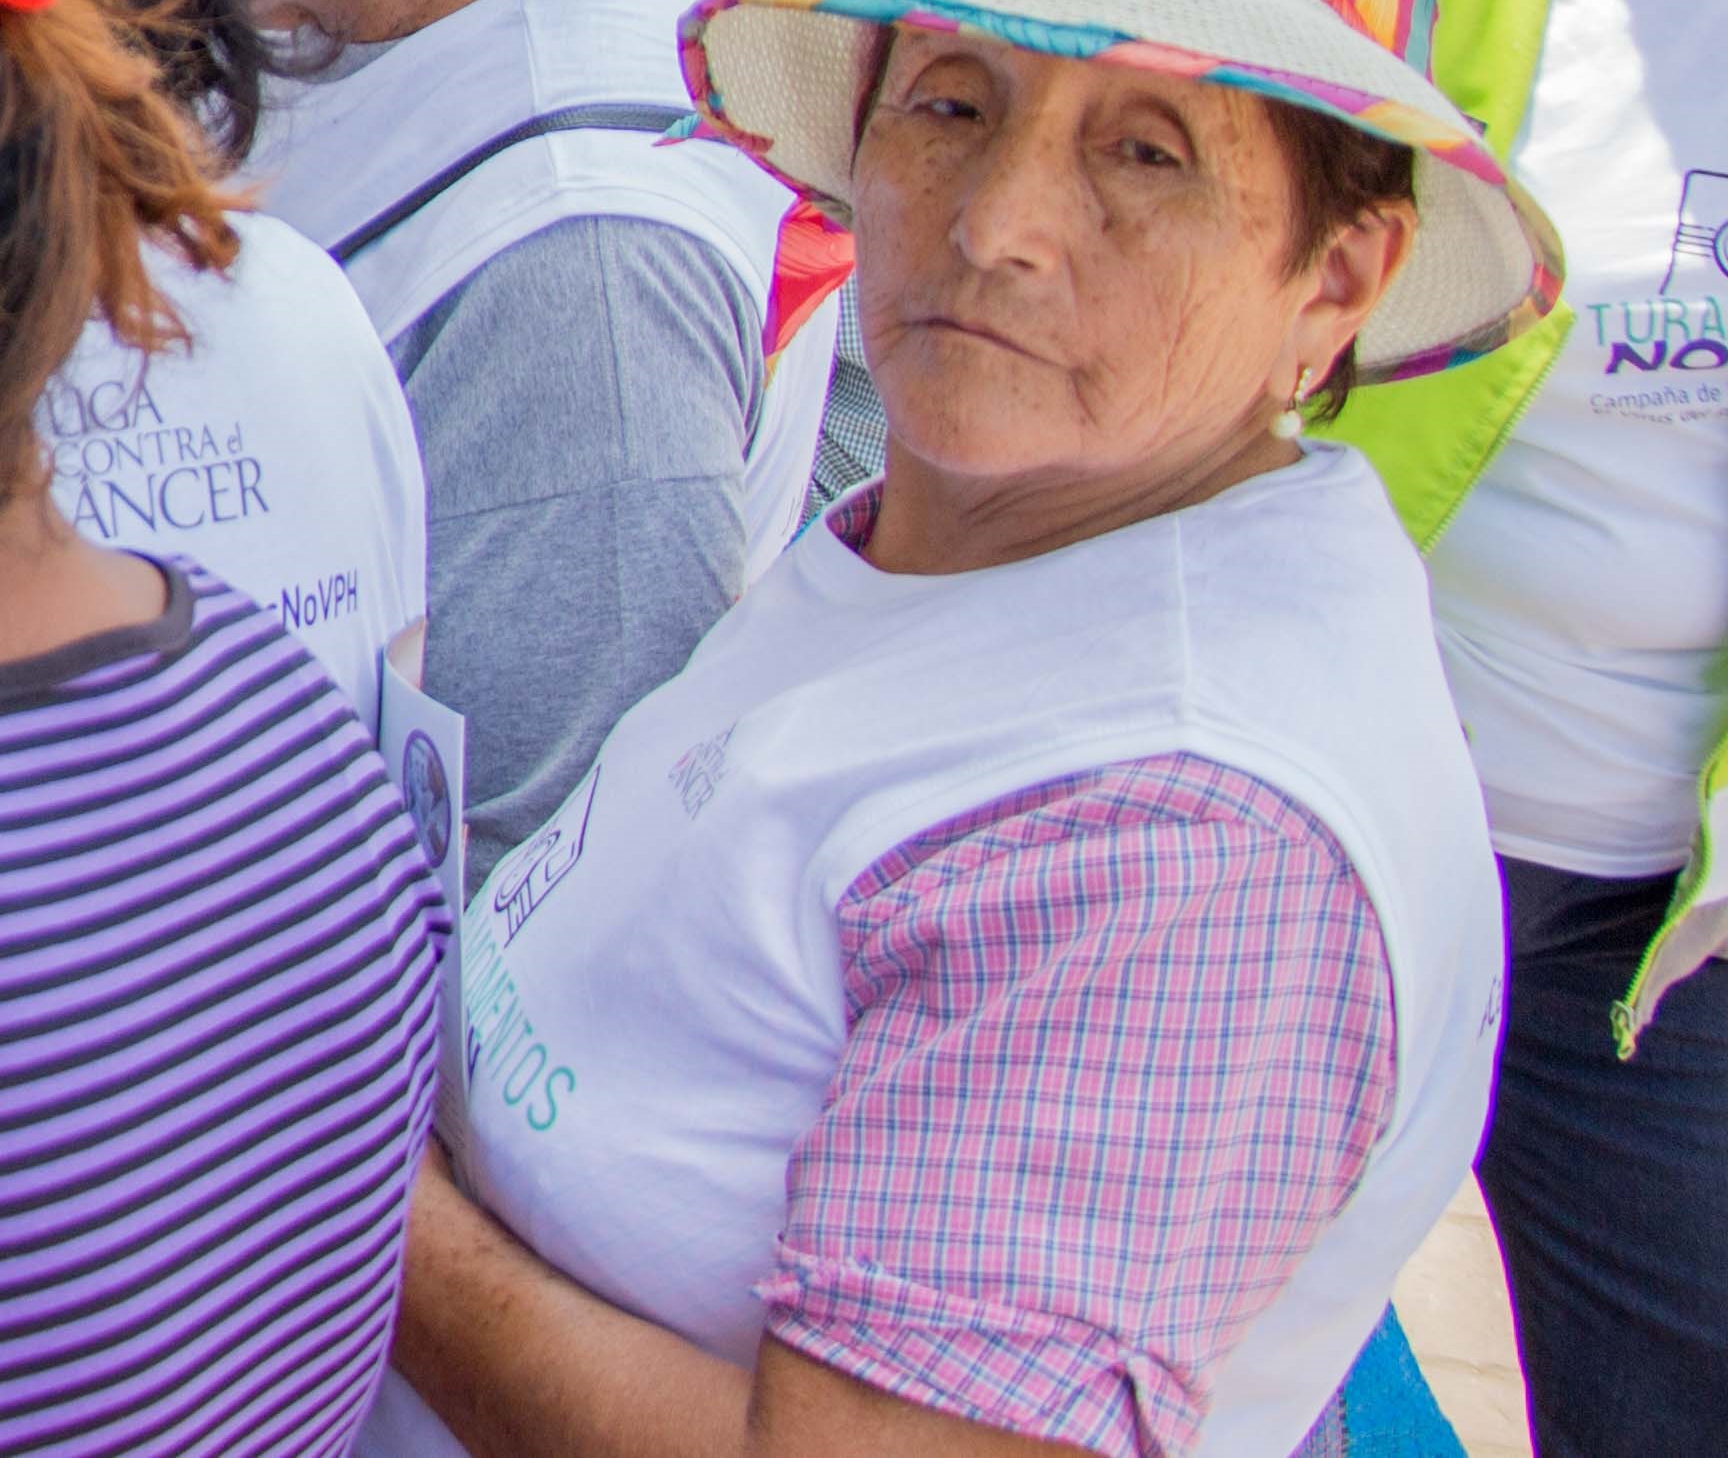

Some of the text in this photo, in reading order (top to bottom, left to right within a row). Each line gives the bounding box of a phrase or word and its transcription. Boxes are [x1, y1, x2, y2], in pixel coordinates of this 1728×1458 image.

[1605, 337, 1728, 374] NO
[1696, 383, 1722, 403] de
[53, 423, 220, 479] CONTRA
